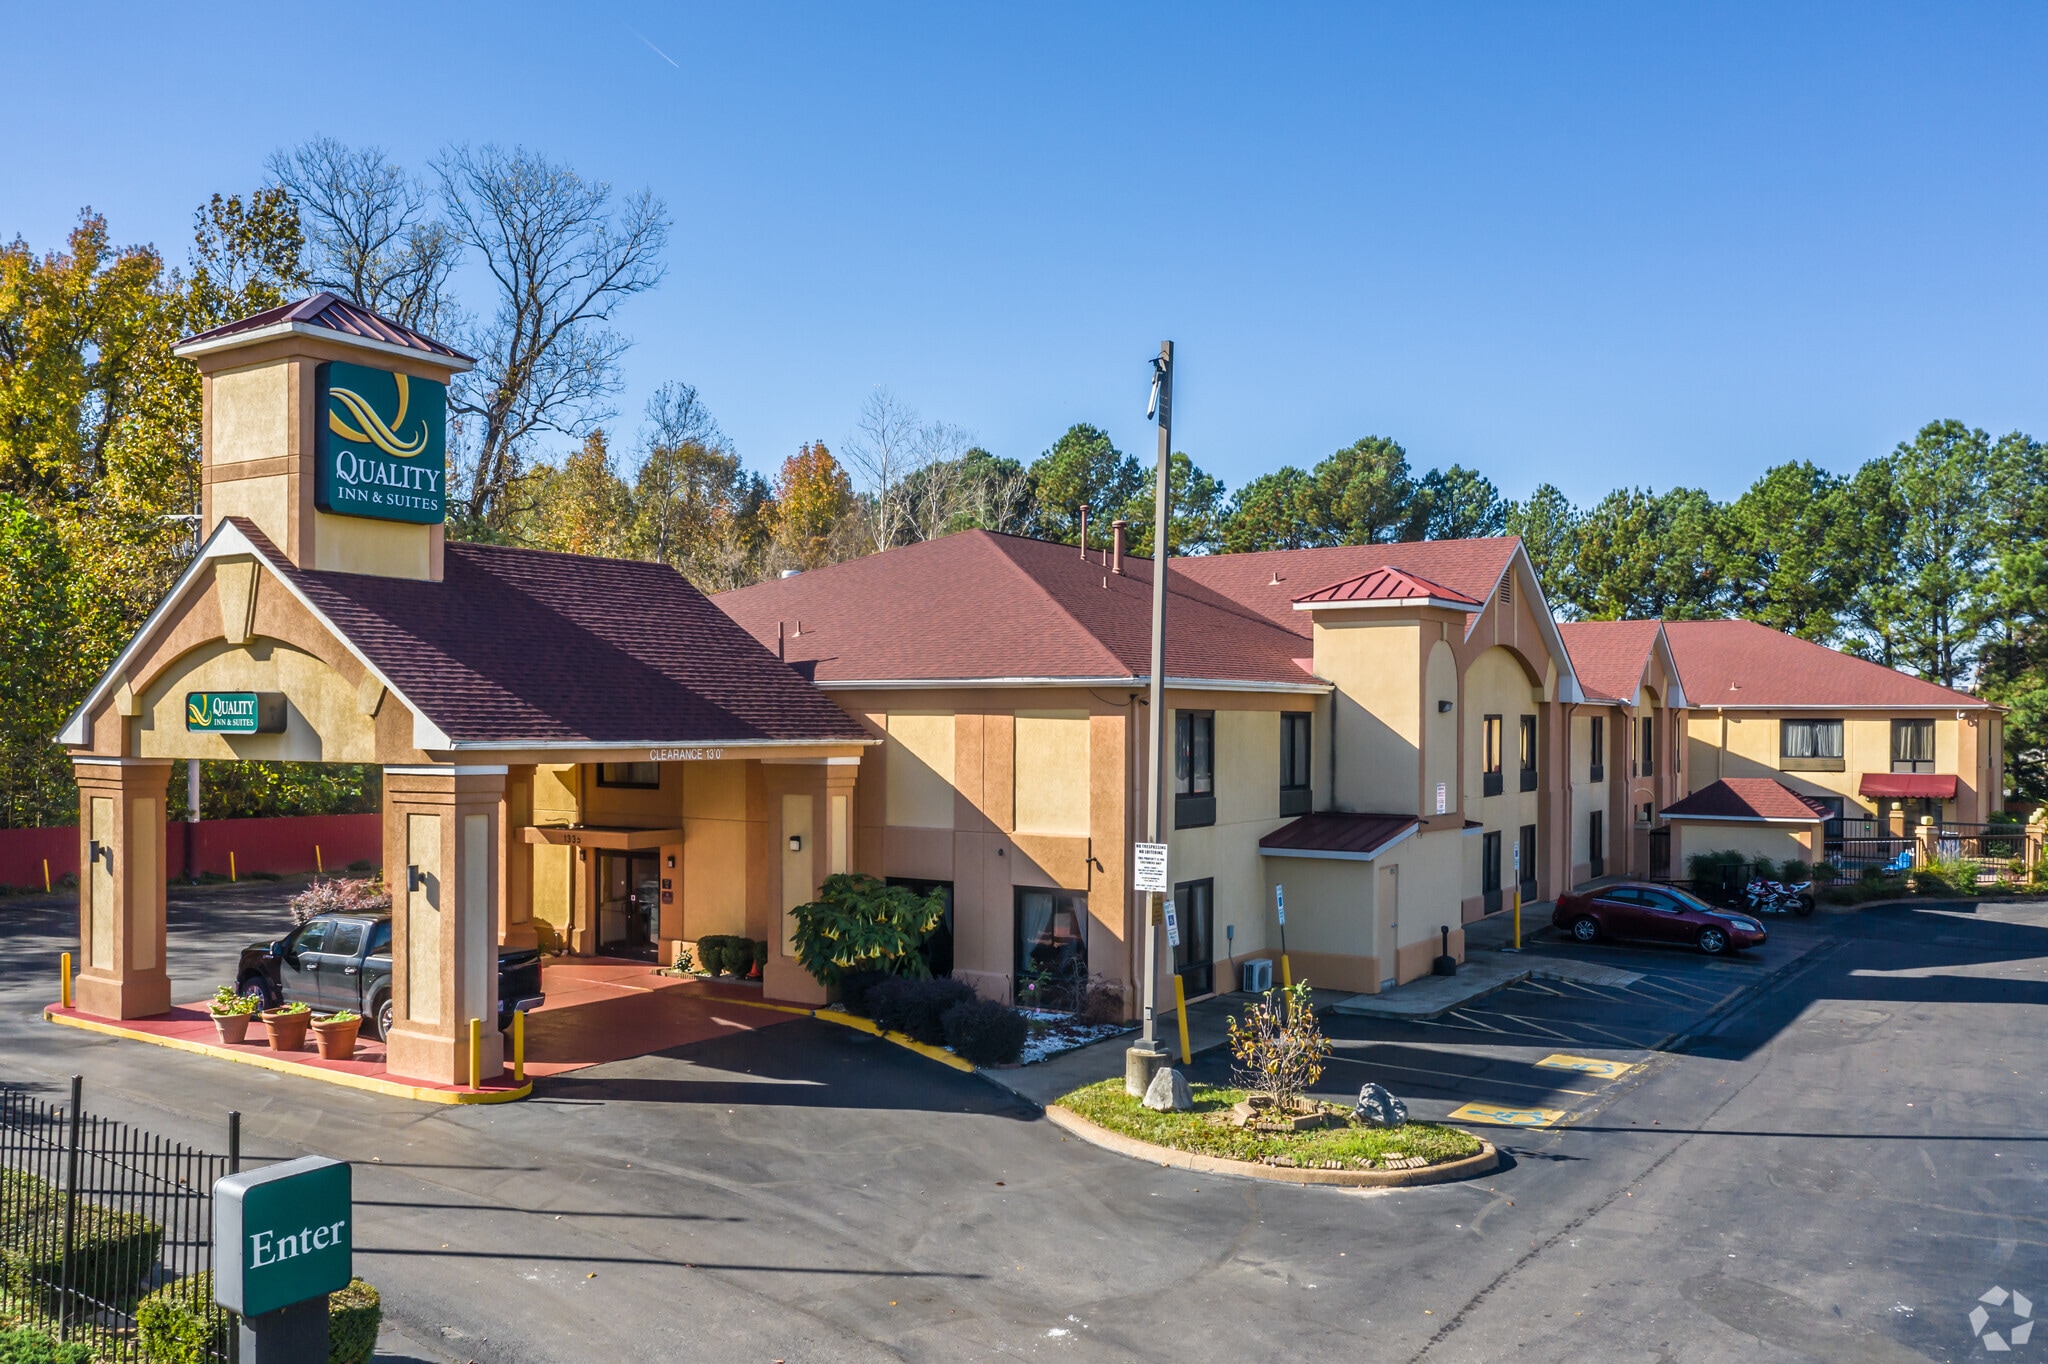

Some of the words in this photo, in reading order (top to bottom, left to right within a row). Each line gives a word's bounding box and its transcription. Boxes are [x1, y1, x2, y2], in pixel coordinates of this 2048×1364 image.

[336, 450, 440, 492] QUALITY
[338, 486, 369, 502] INN
[372, 491, 383, 504] &
[386, 493, 438, 511] SUITES
[213, 697, 254, 717] QUALITY
[214, 718, 226, 726] INN
[227, 718, 231, 726] &
[232, 718, 254, 727] SUITES
[649, 748, 703, 761] CLEARANCE
[249, 1220, 345, 1269] Enter
